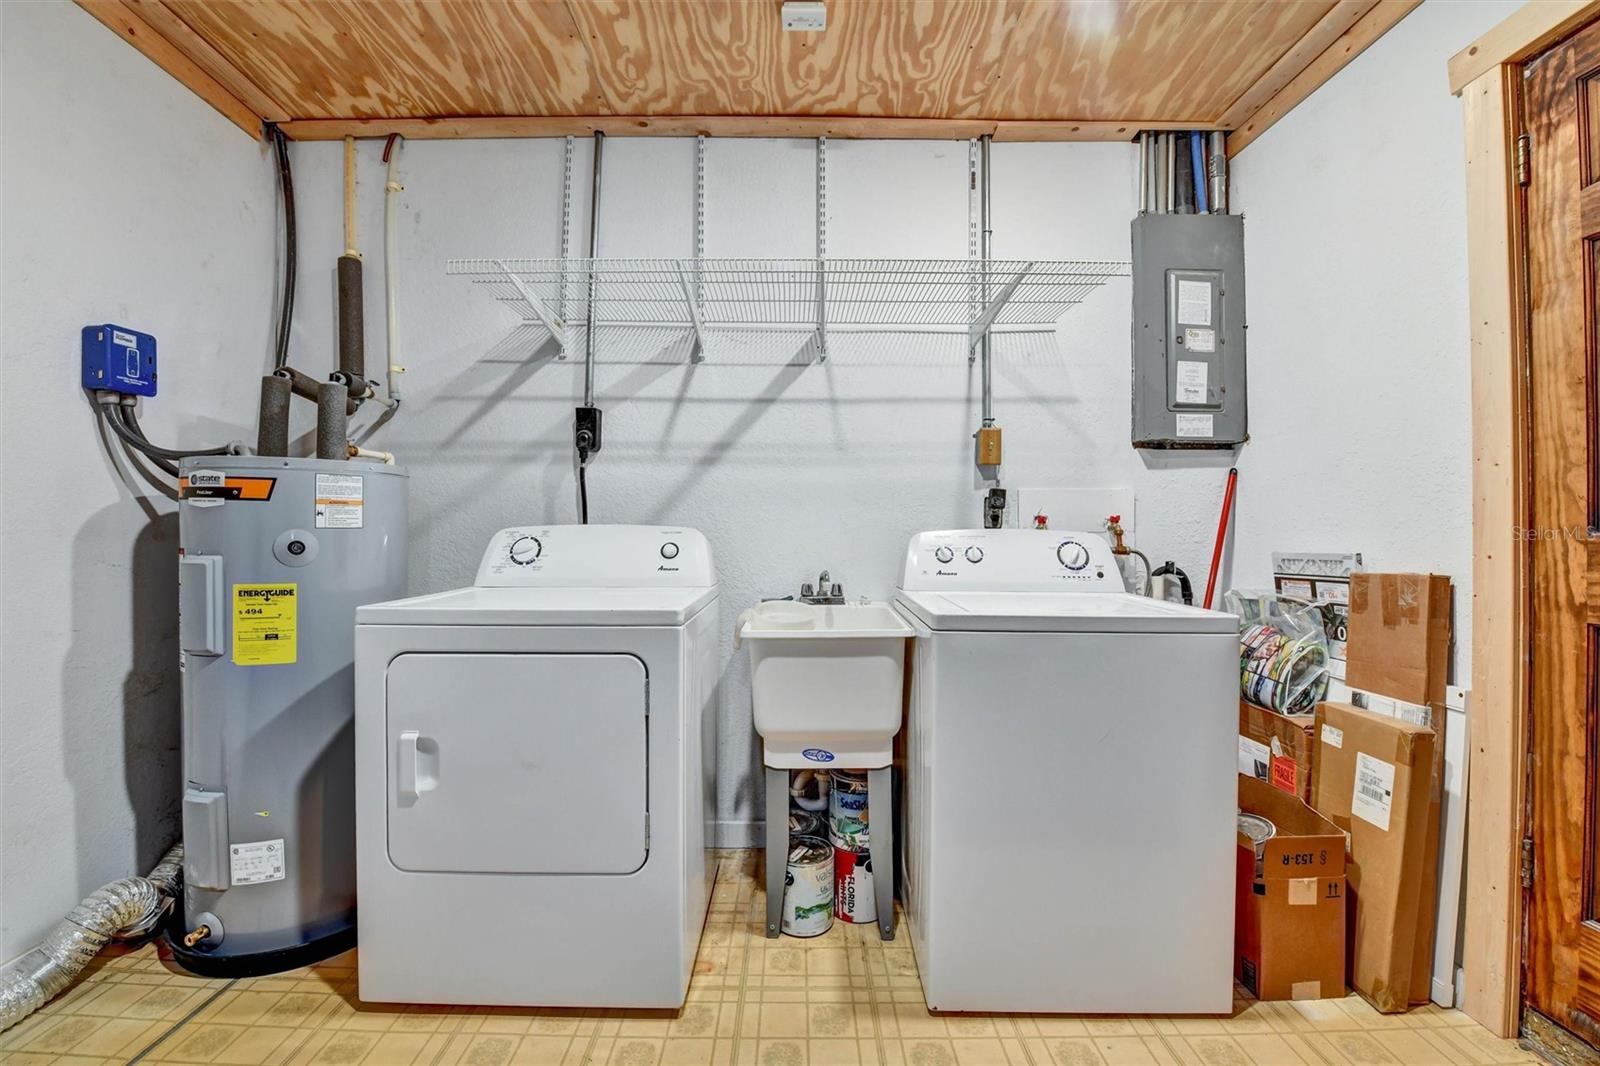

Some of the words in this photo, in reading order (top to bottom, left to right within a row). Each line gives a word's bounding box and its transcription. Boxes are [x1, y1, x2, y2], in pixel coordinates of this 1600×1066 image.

[1274, 764, 1295, 785] FRAGILE
[1282, 854, 1313, 866] 153-R
[847, 876, 856, 914] FLORIDA
